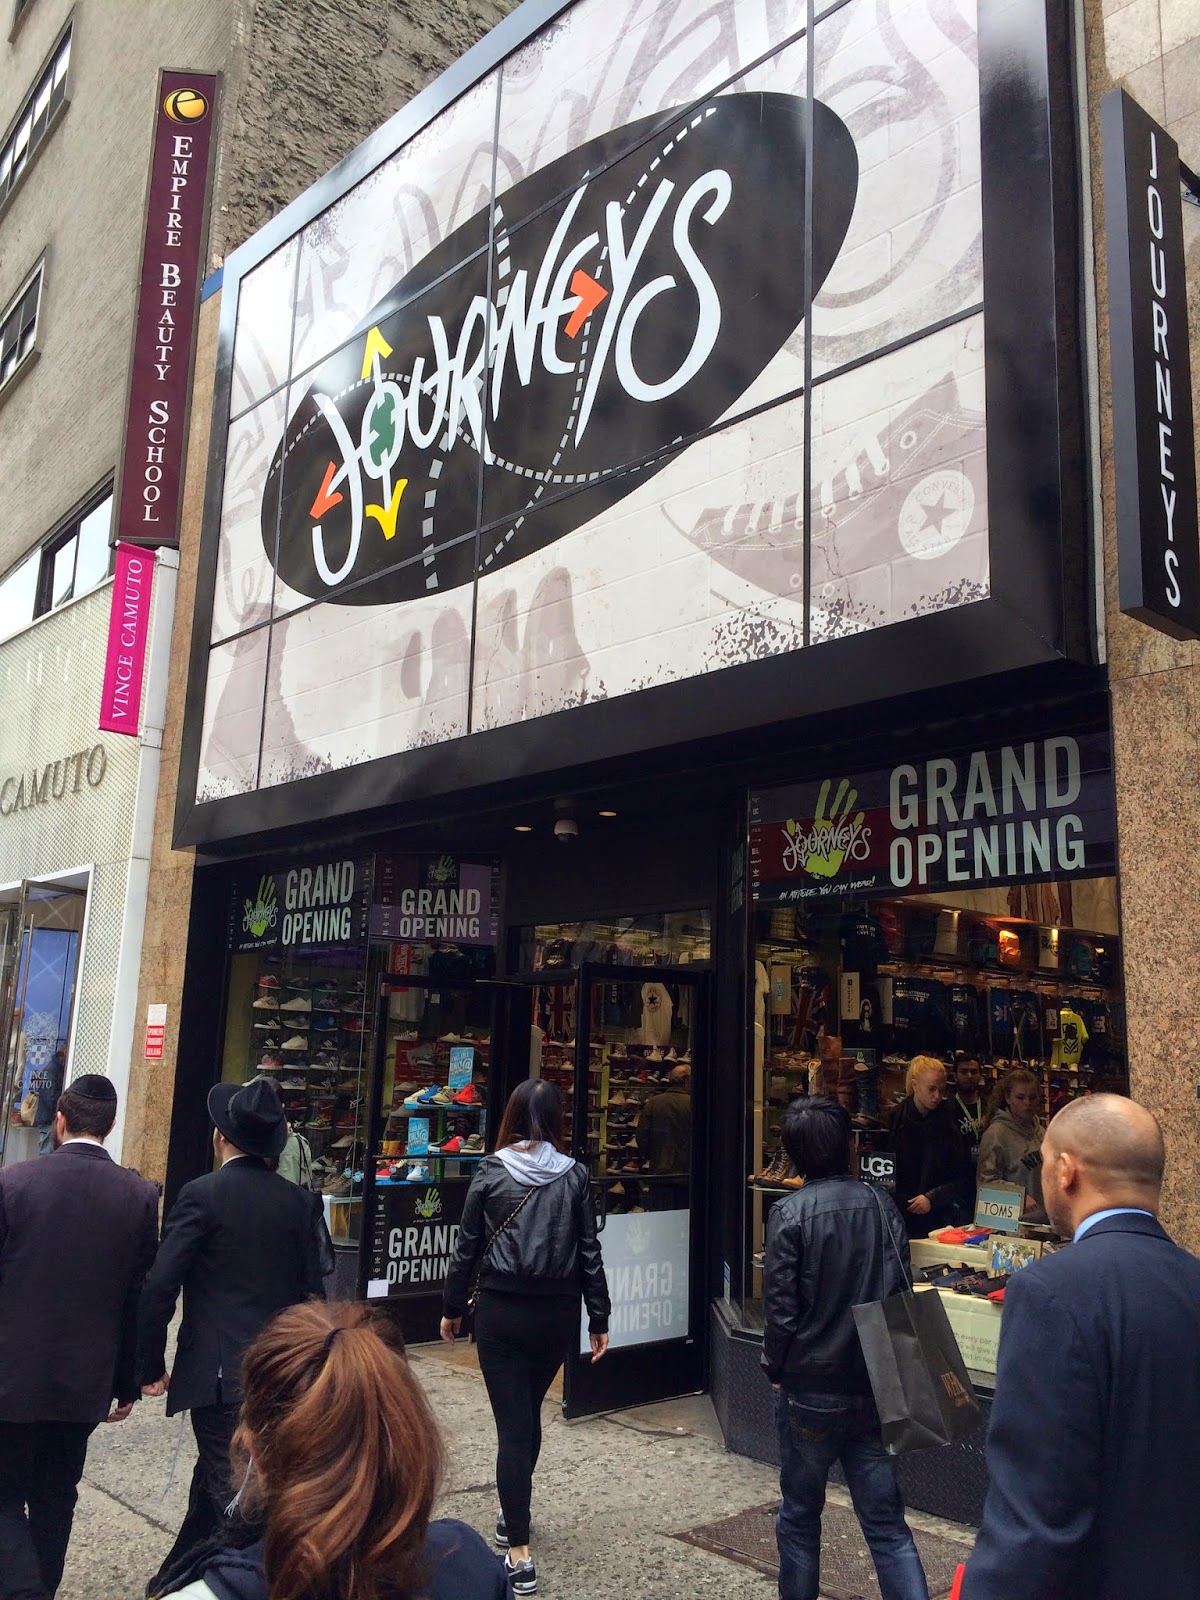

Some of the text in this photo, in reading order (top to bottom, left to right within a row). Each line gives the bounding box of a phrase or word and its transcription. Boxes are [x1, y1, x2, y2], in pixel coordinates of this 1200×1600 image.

[311, 167, 732, 587] JOURNEYS
[1148, 131, 1182, 608] JOURNEYS
[112, 559, 144, 719] VINCE CAMUTO
[0, 743, 108, 816] CAMUTO
[889, 735, 1083, 831] GRAND
[781, 815, 872, 872] JOURNEYS
[889, 813, 1087, 888] OPENING
[285, 860, 356, 911] GRAND
[400, 888, 482, 916] GRAND
[281, 906, 352, 946] OPENING
[399, 917, 481, 939] OPENING
[17, 1080, 52, 1089] CAMUTO
[24, 1071, 49, 1080] VINCE
[860, 1156, 894, 1177] UGG
[983, 1201, 1013, 1219] TOMS
[386, 1256, 450, 1285] OPENIN
